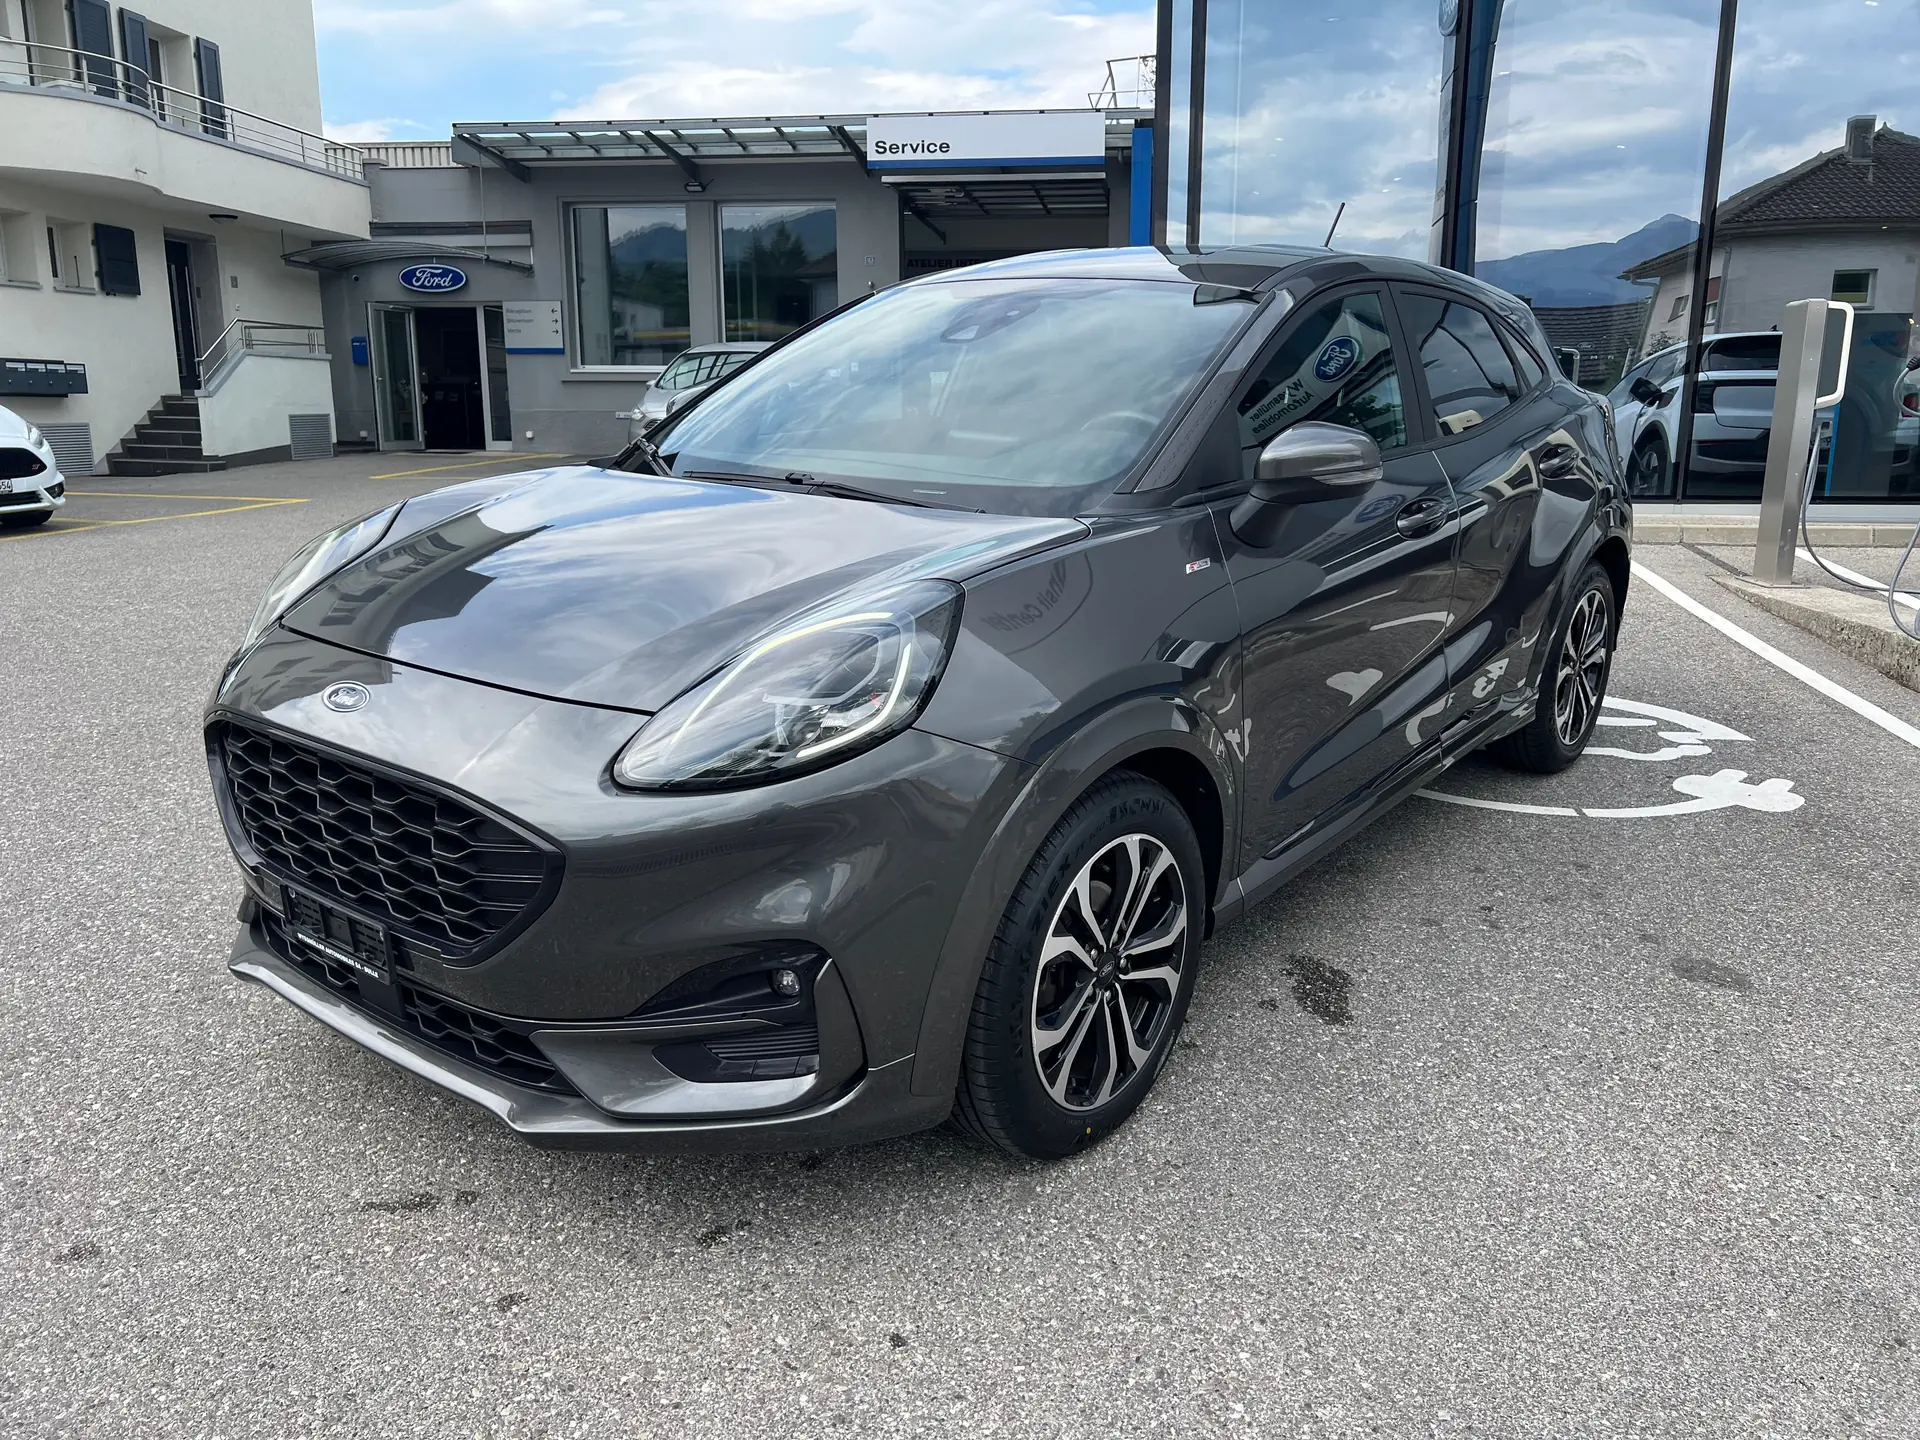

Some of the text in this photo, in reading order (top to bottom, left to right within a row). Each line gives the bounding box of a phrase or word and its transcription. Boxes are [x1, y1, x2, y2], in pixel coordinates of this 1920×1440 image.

[874, 140, 951, 155] Service
[906, 258, 951, 268] ATELIER
[411, 266, 454, 288] Ford
